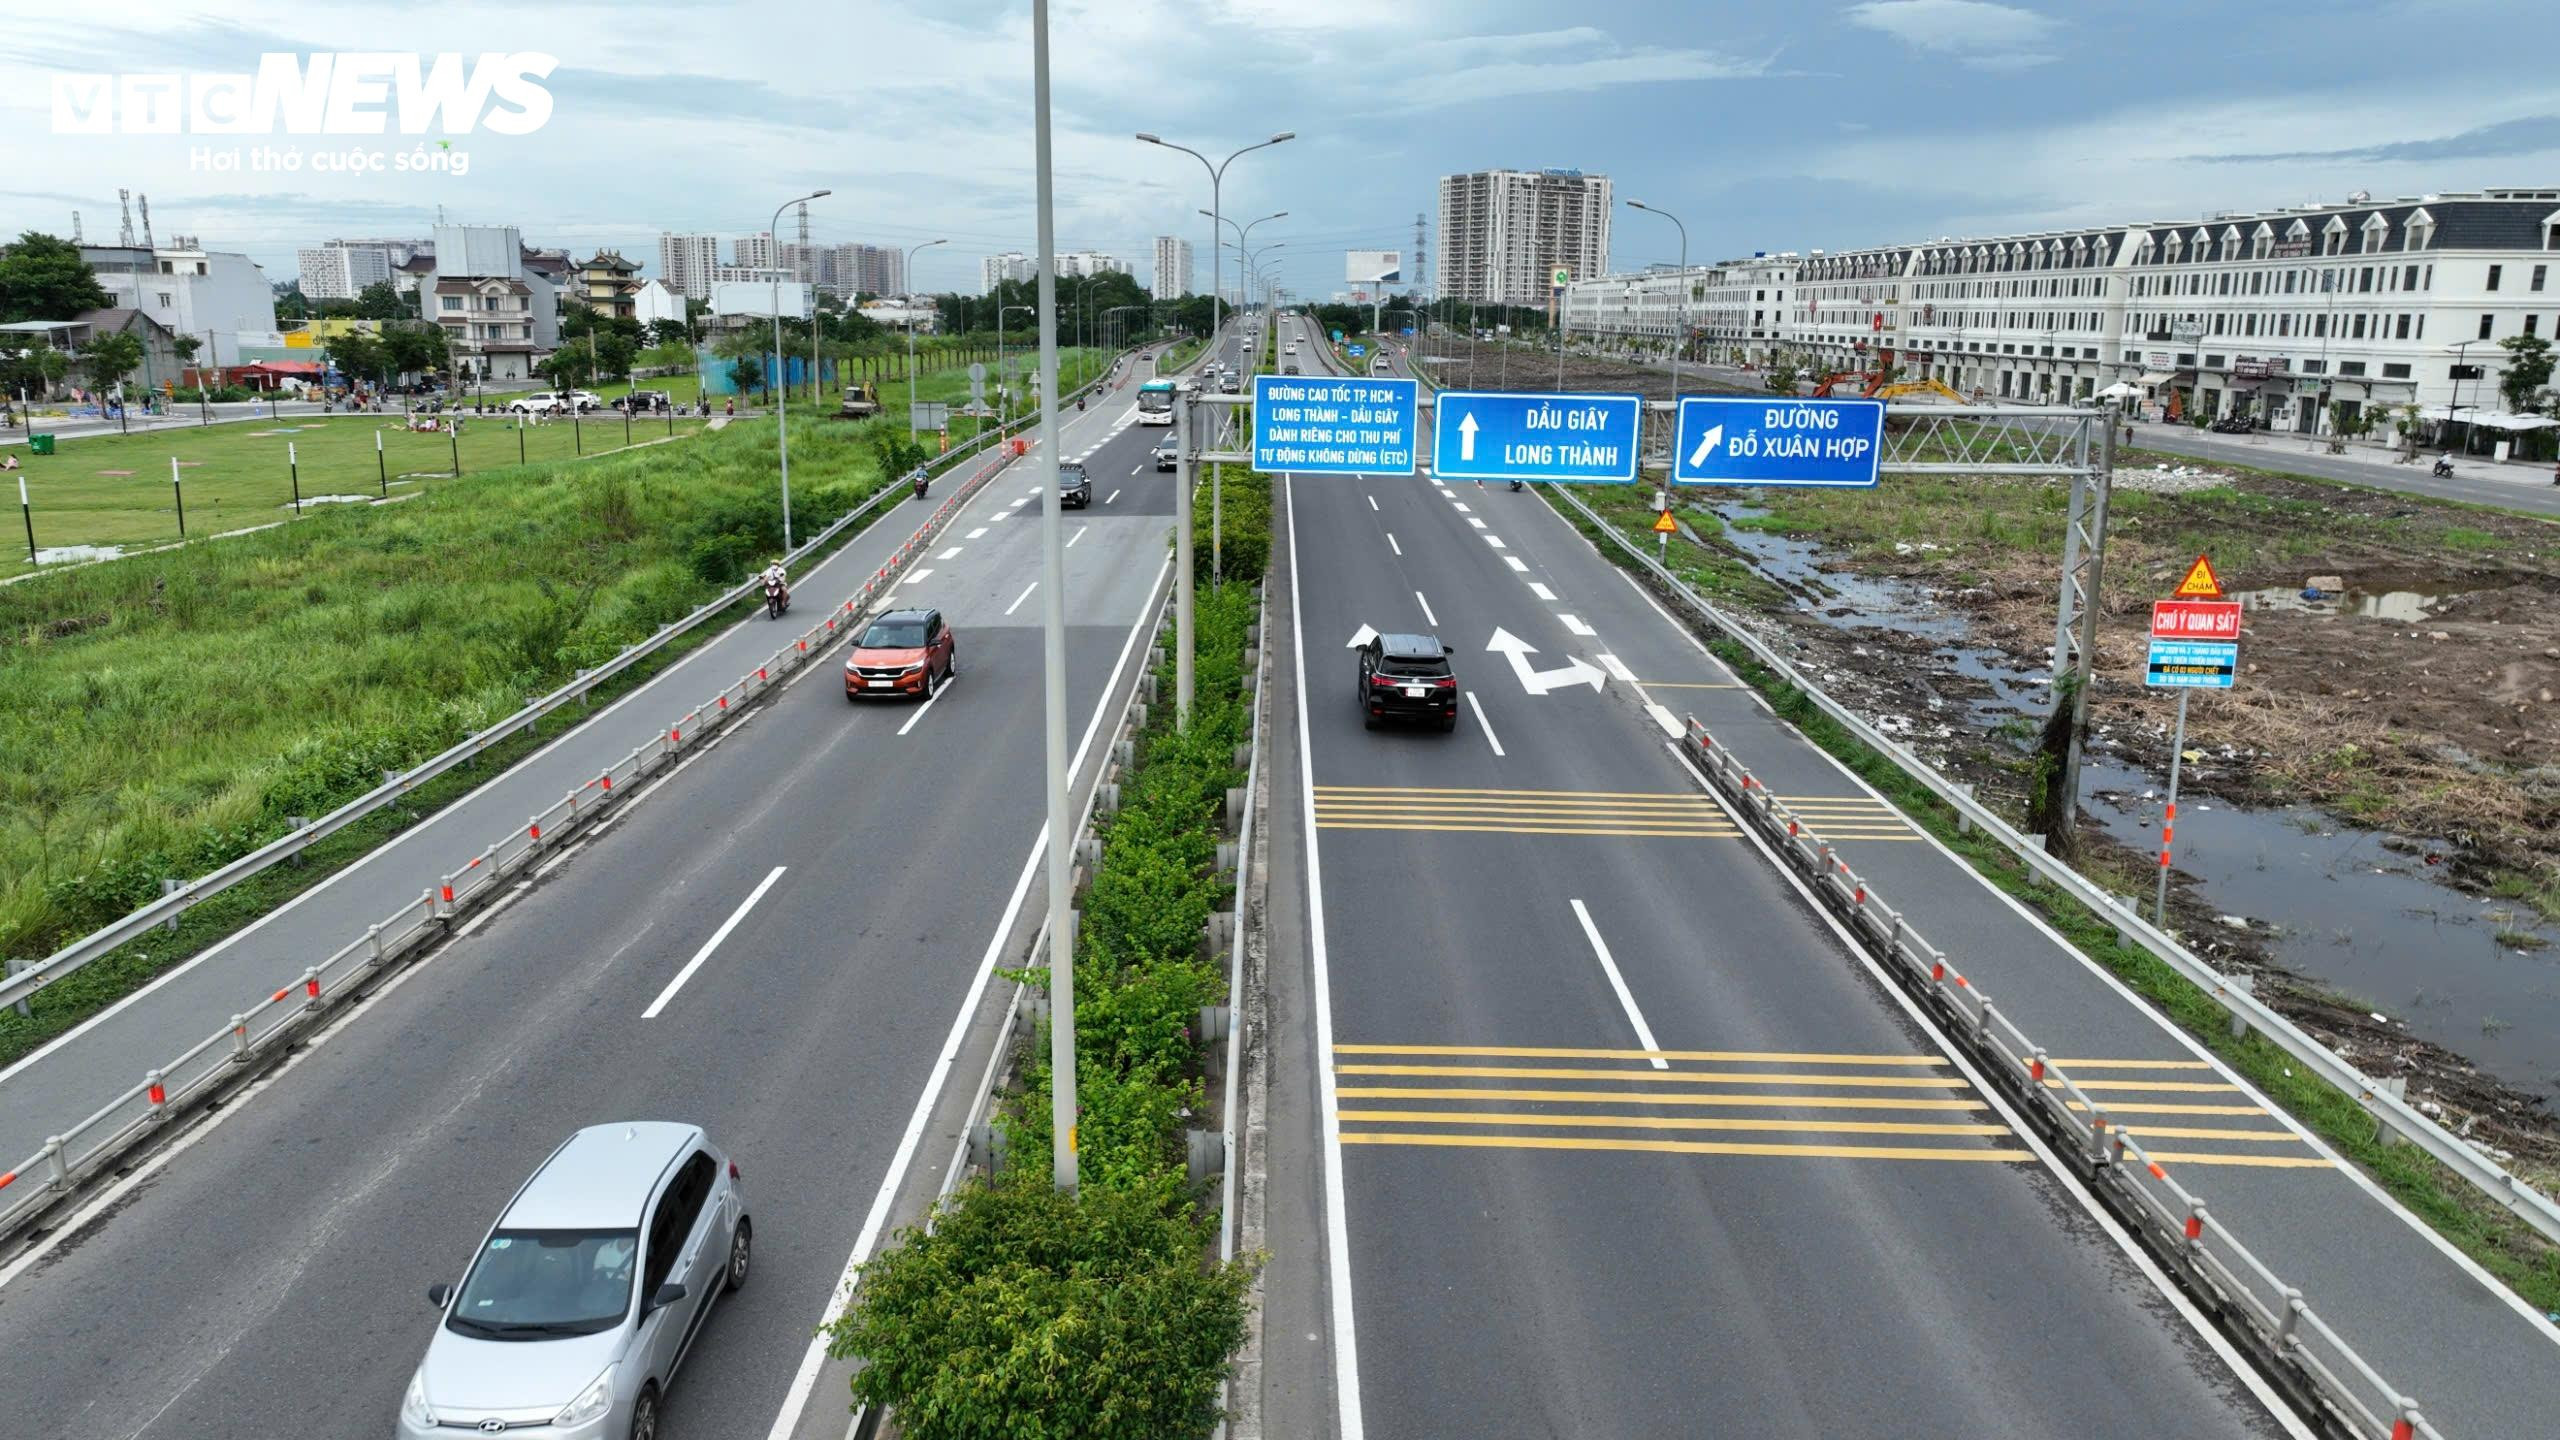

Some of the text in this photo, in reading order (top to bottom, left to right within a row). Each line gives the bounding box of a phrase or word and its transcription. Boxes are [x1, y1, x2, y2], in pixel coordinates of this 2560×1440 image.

[1268, 384, 1305, 401] ĐƯỜNG
[1308, 389, 1328, 401] CAO
[1331, 384, 1350, 402] TỐC
[1354, 389, 1366, 402] TP.
[1370, 390, 1393, 403] HCM
[1272, 408, 1300, 422] LONG
[1304, 406, 1338, 423] THÀNH
[1351, 405, 1371, 423] DẦU
[1375, 408, 1398, 424] GIÂY
[1526, 401, 1609, 431] DẦU GIÂY
[1765, 403, 1839, 429] ĐƯỜNG
[1269, 426, 1401, 444] DÀNH RIÊNG CHO THU PHÍ
[1729, 429, 1870, 461] ĐỖ XUÂN HỢP
[1260, 447, 1407, 465] TỰ ĐỘNG KHÔNG DỪNG (ETC)
[1505, 440, 1617, 466] LONG THÀNH
[2157, 609, 2237, 631] CHÚ Ý QUAN SÁT
